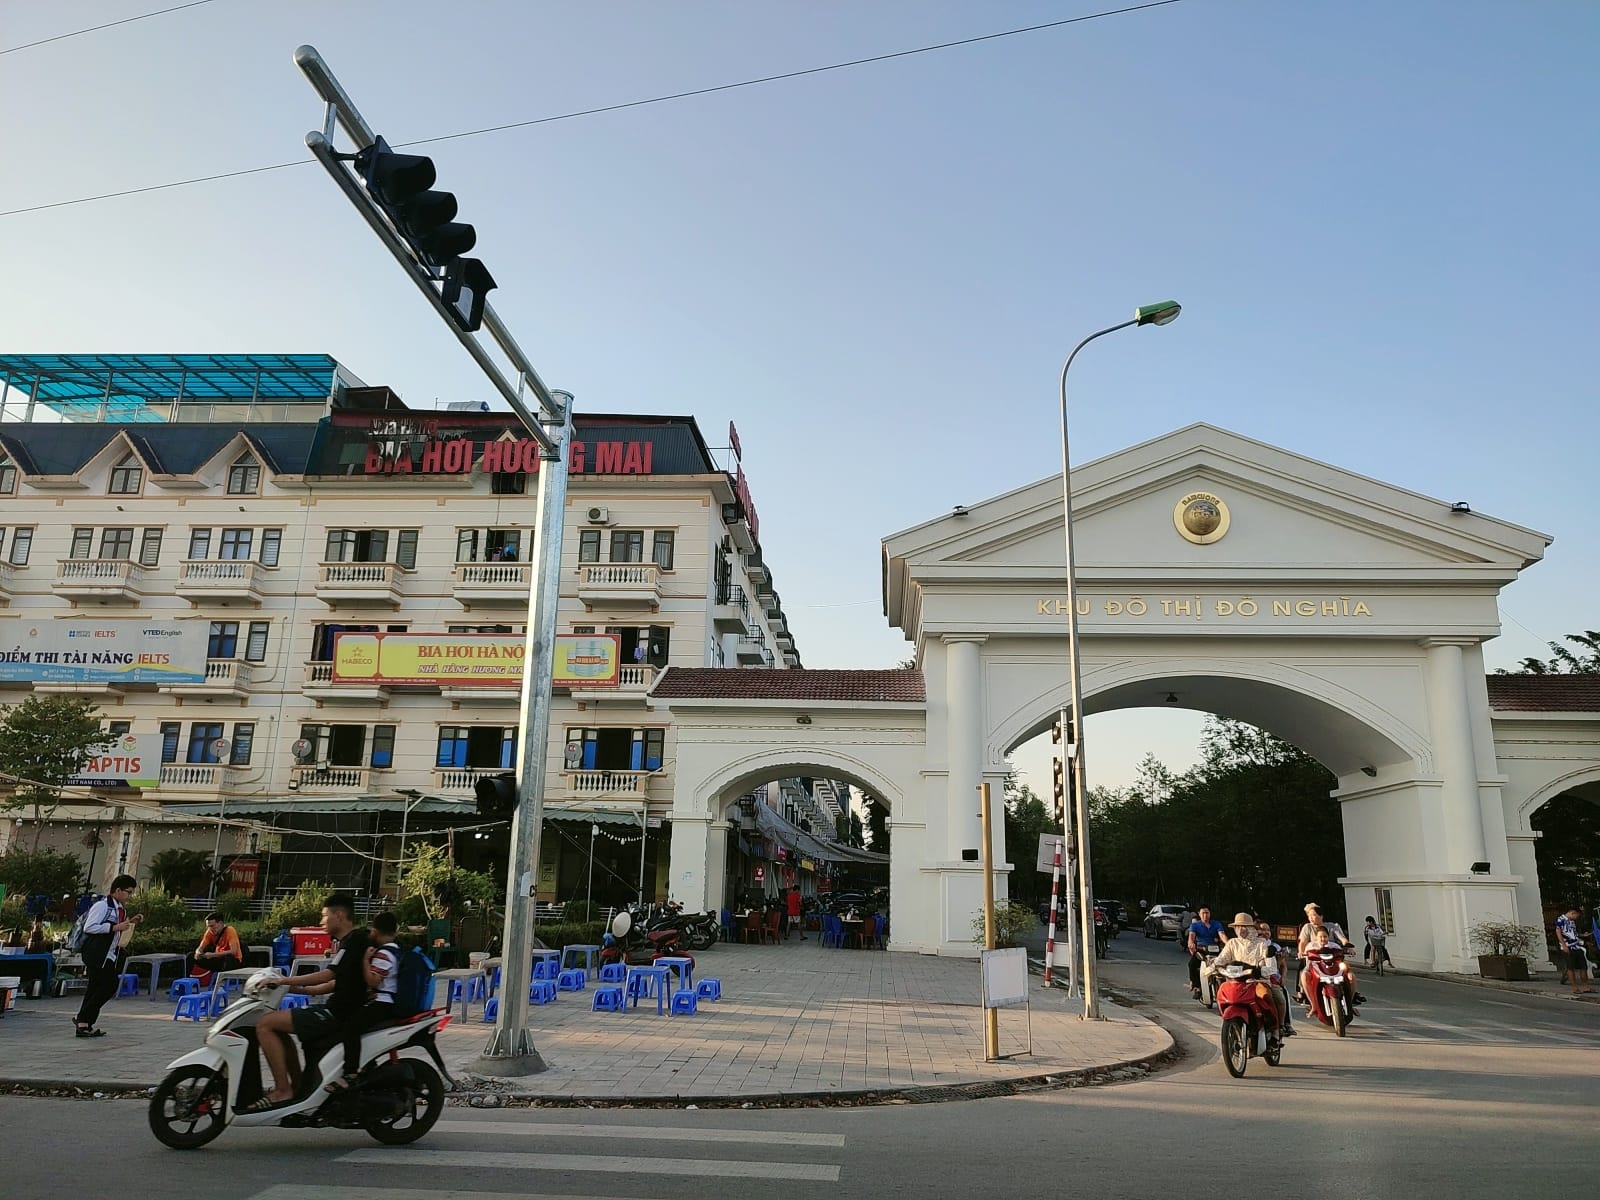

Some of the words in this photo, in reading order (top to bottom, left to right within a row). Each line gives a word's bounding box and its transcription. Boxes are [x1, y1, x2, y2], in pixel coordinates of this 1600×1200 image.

[422, 437, 473, 473] HƠI
[482, 437, 585, 473] HƯƠG
[595, 440, 653, 473] MAI
[1037, 599, 1090, 615] KHU
[1104, 594, 1147, 615] ĐÔ
[1160, 595, 1202, 621] THỊ
[1272, 596, 1373, 617] NGHĨA
[35, 652, 59, 663] THI
[91, 649, 134, 665] NĂNG
[137, 653, 170, 665] IELTS
[417, 646, 442, 657] BIA
[477, 643, 499, 658] HÀ
[502, 644, 525, 661] NỘ
[87, 757, 141, 773] APTIS
